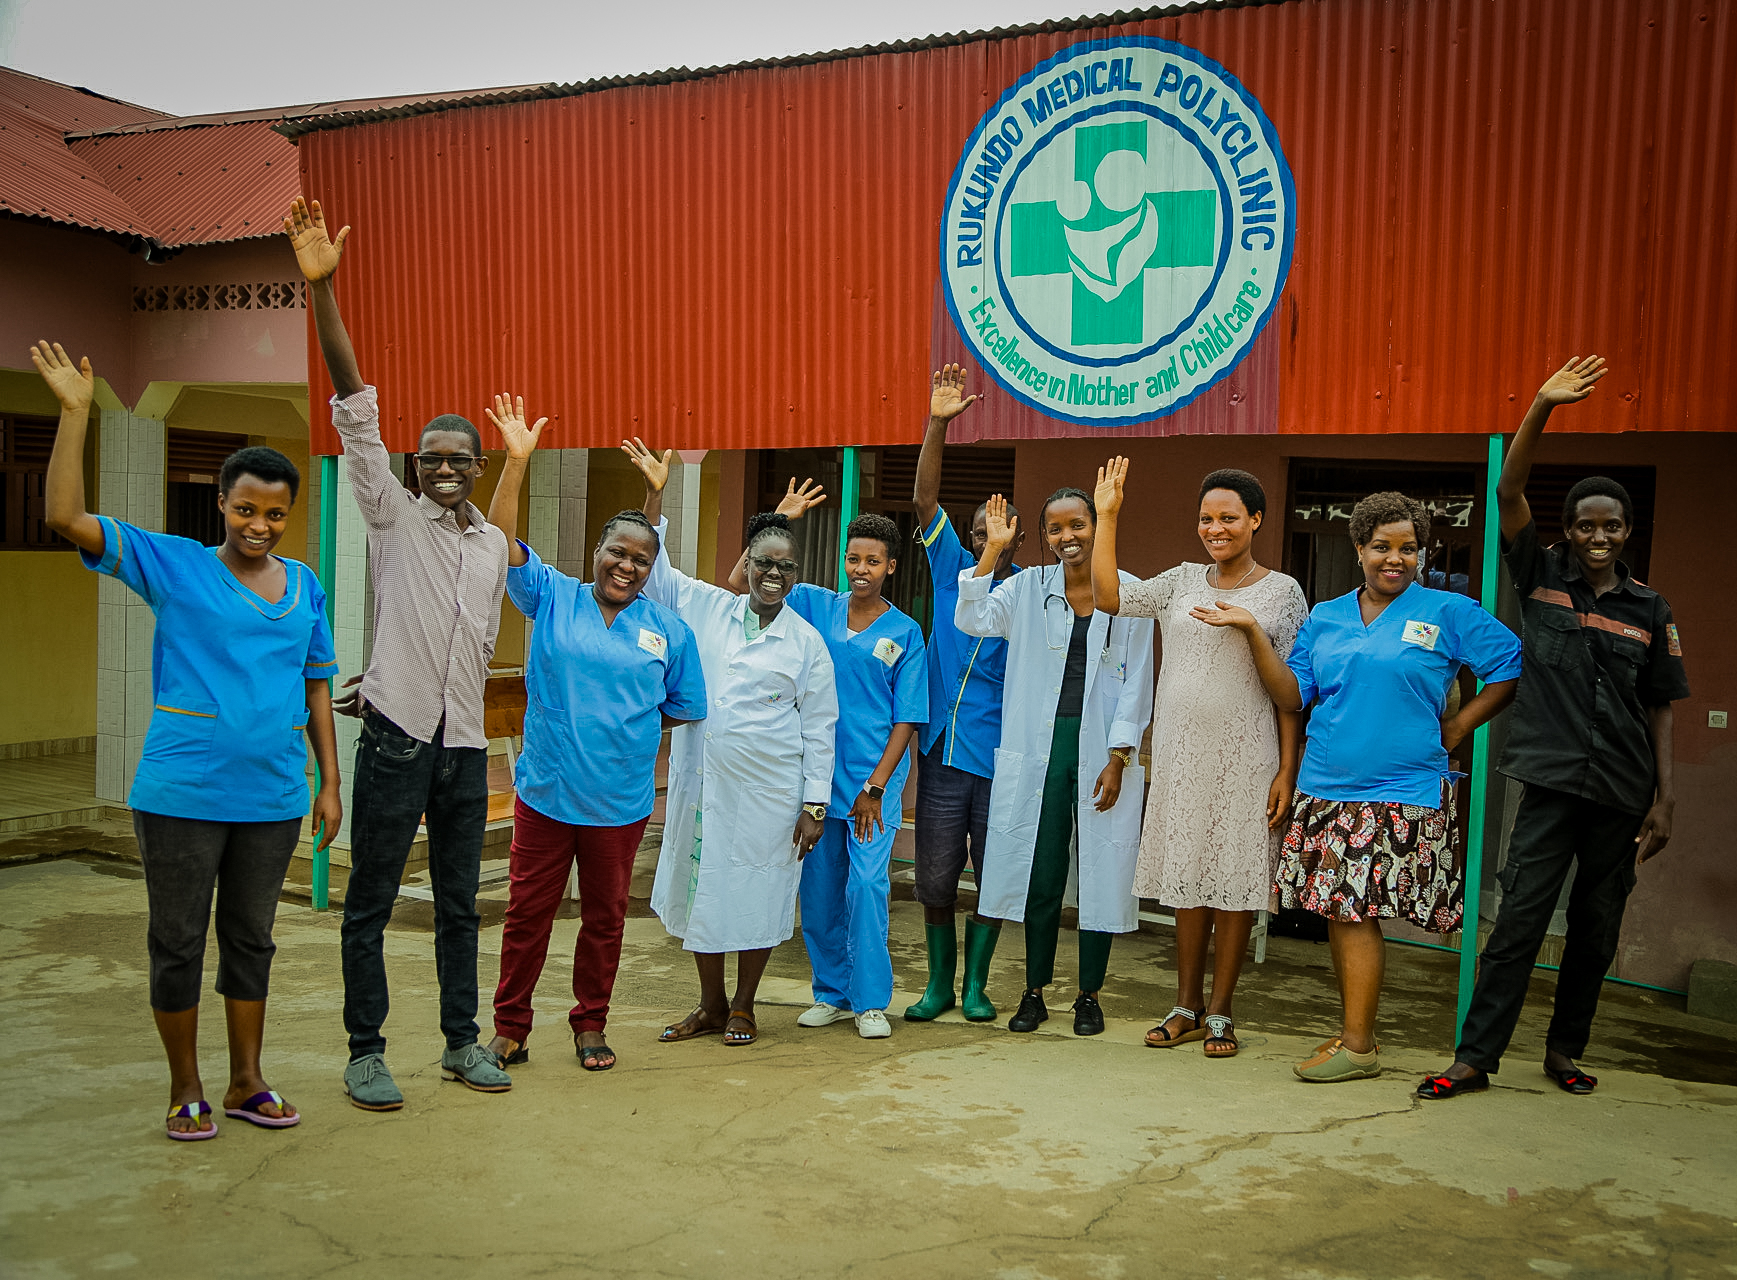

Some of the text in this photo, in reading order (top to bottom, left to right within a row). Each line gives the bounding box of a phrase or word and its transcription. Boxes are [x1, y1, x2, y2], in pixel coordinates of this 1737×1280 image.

[957, 57, 1277, 268] RUKUNDO MEDICAL POLYCLINIC
[968, 296, 1048, 392] Excellence
[1047, 376, 1066, 401] in
[1145, 355, 1180, 398] and
